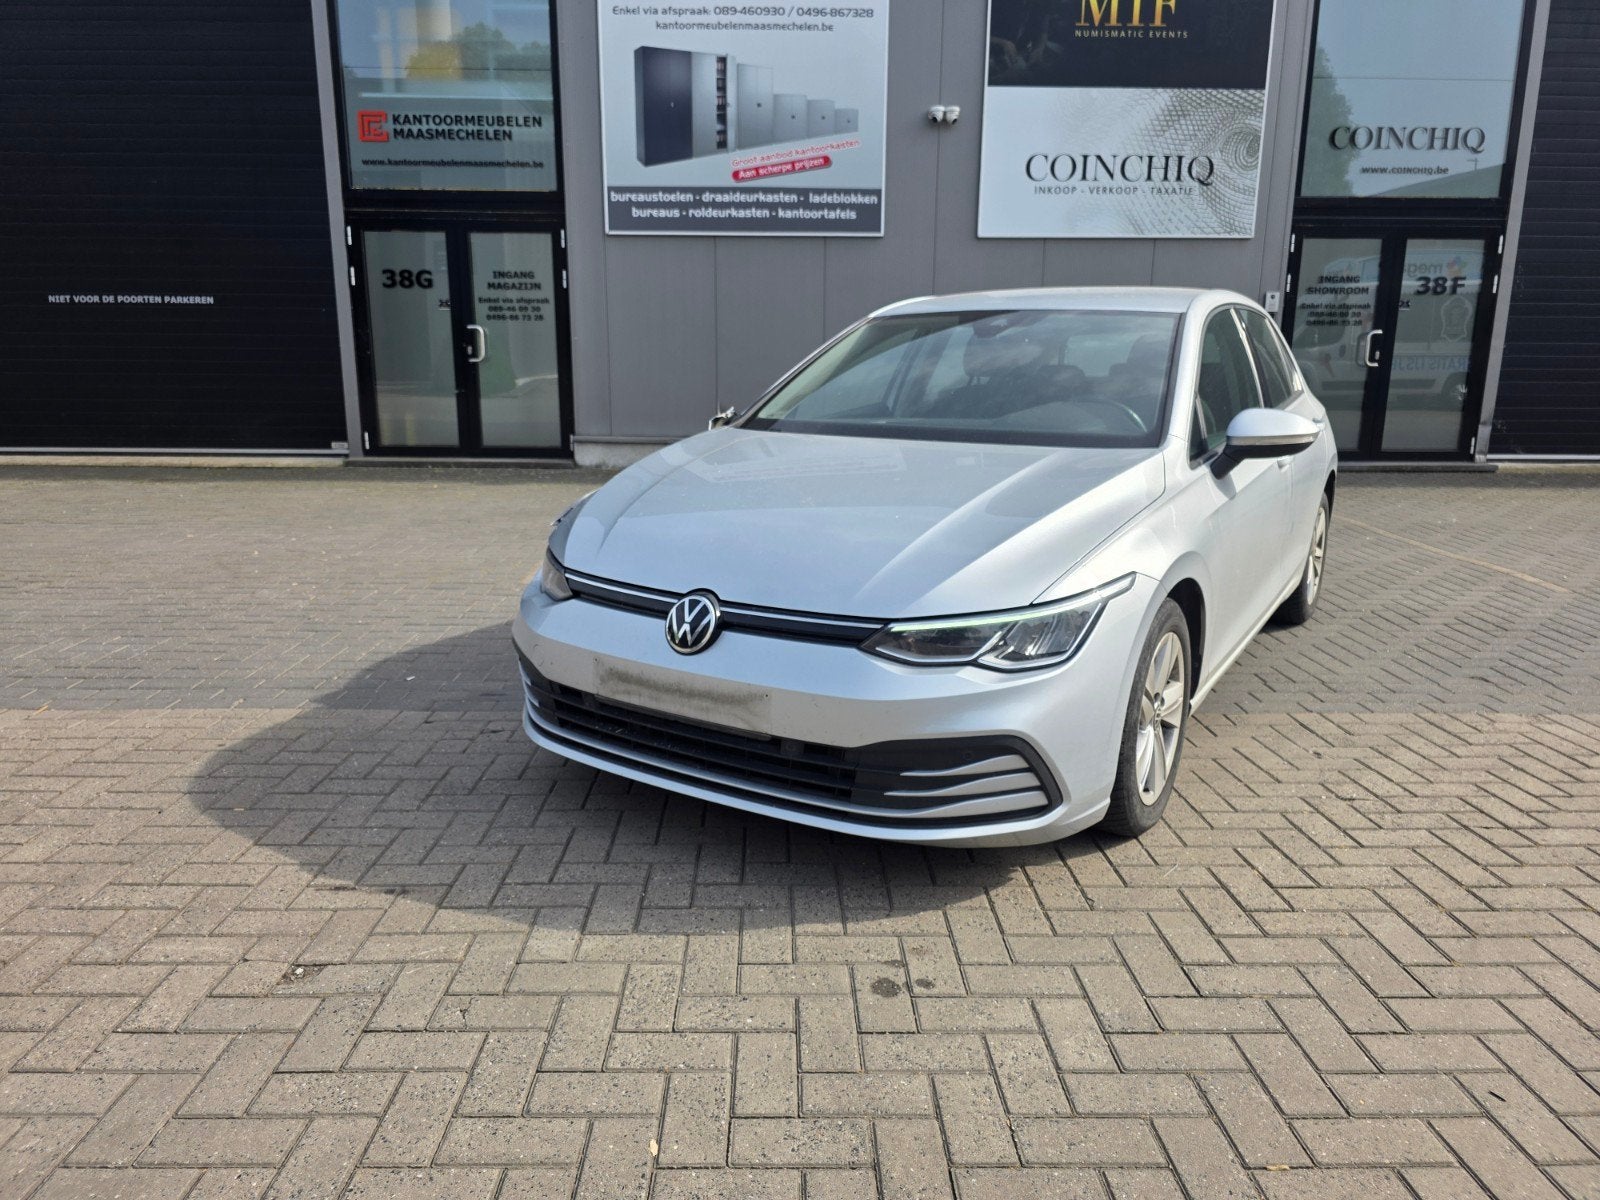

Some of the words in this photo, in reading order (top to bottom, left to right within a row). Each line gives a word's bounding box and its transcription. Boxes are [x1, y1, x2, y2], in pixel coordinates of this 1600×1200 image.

[612, 5, 640, 16] Enkel
[643, 6, 659, 16] via
[714, 6, 786, 18] 089-460930
[796, 7, 874, 19] 0496-867328
[656, 20, 834, 32] kantoormeubelenmaasmechelen.be
[1074, 29, 1144, 38] NUMISMATIC
[1149, 30, 1188, 39] EVENTS
[392, 114, 542, 127] KANTOORMEUBELEN
[393, 128, 512, 141] MAASMECHELEN
[1329, 126, 1486, 154] COINCHIQ
[361, 158, 544, 168] www.kantoormeubelenmaasmechelen.be
[739, 168, 757, 179] Aan
[759, 162, 793, 176] scherpe
[794, 157, 825, 171] prijzen
[1025, 153, 1215, 187] COINCHIQ
[1034, 186, 1077, 195] INKOOP
[1088, 186, 1138, 196] VERKOOP
[1151, 187, 1194, 196] TAXATIE
[610, 191, 694, 203] bureaustoelen
[701, 191, 798, 203] draaideurkasten
[809, 193, 878, 205] ladeblokken
[632, 207, 680, 218] bureaus
[688, 207, 770, 219] roldeurkasten
[778, 208, 857, 220] kantoortafels
[381, 269, 433, 289] 38G
[493, 271, 535, 280] INGANG
[1318, 276, 1360, 284] INGANG
[487, 282, 541, 291] MAGAZIJN
[1306, 287, 1369, 295] SHOWROOM
[1415, 276, 1466, 295] 38F
[48, 295, 71, 303] NIET
[73, 295, 100, 303] VOOR
[102, 295, 115, 303] DE
[117, 295, 161, 304] POORTEN
[164, 295, 214, 305] PARKEREN
